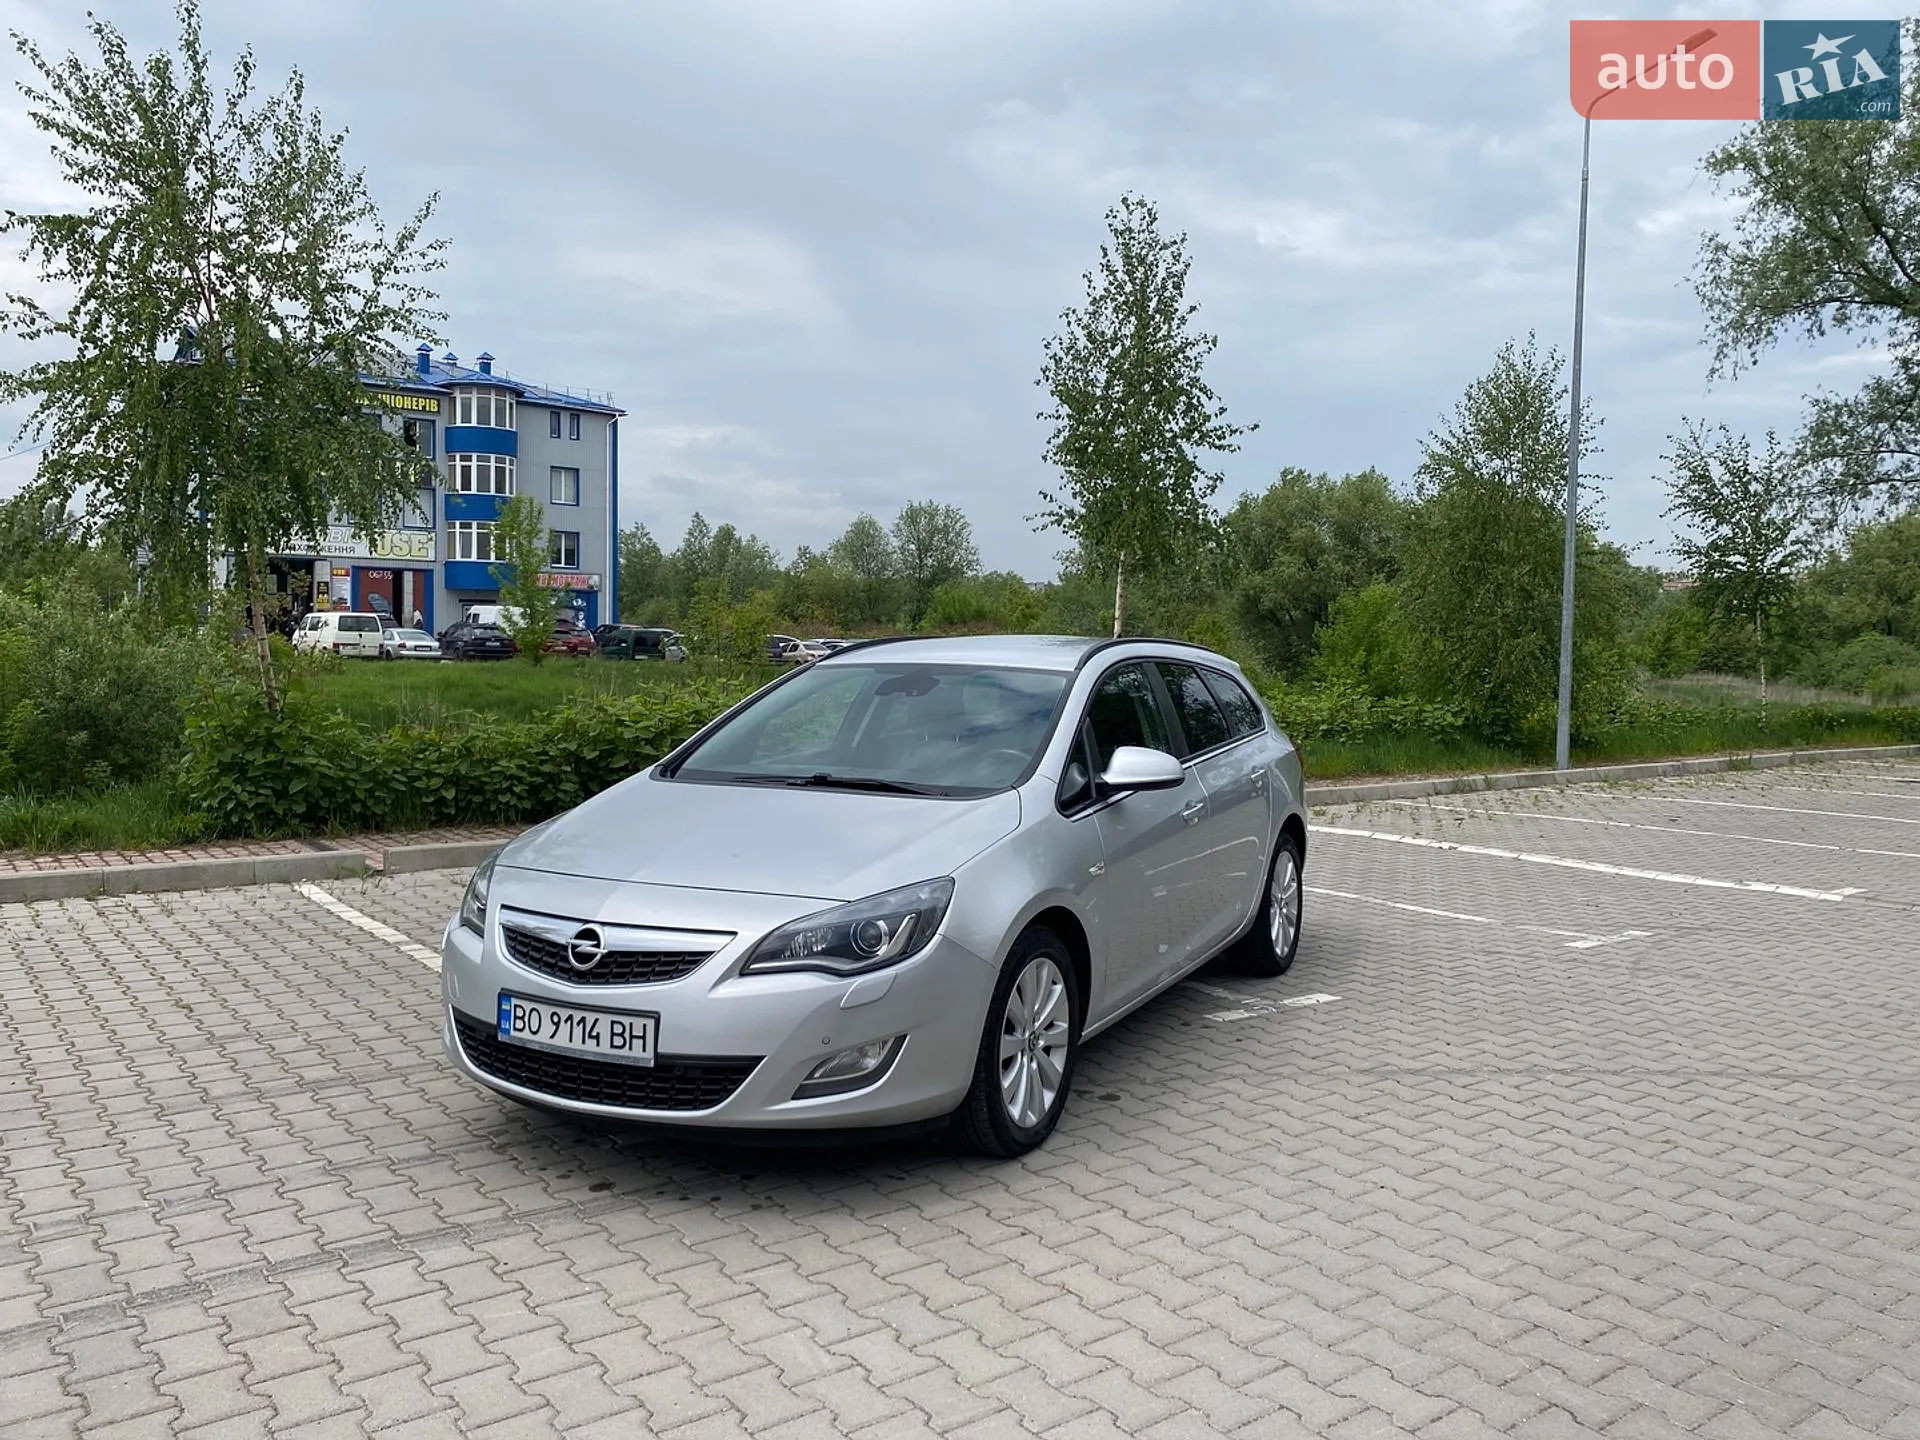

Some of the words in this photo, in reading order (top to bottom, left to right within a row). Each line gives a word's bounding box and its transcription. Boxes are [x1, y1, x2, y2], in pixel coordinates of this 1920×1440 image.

[378, 393, 438, 412] ЦІОНЕРІВ
[375, 531, 429, 558] USE
[501, 1019, 510, 1029] UA
[513, 1003, 542, 1035] BO
[549, 1011, 600, 1047] 9114
[610, 1020, 647, 1053] BH
